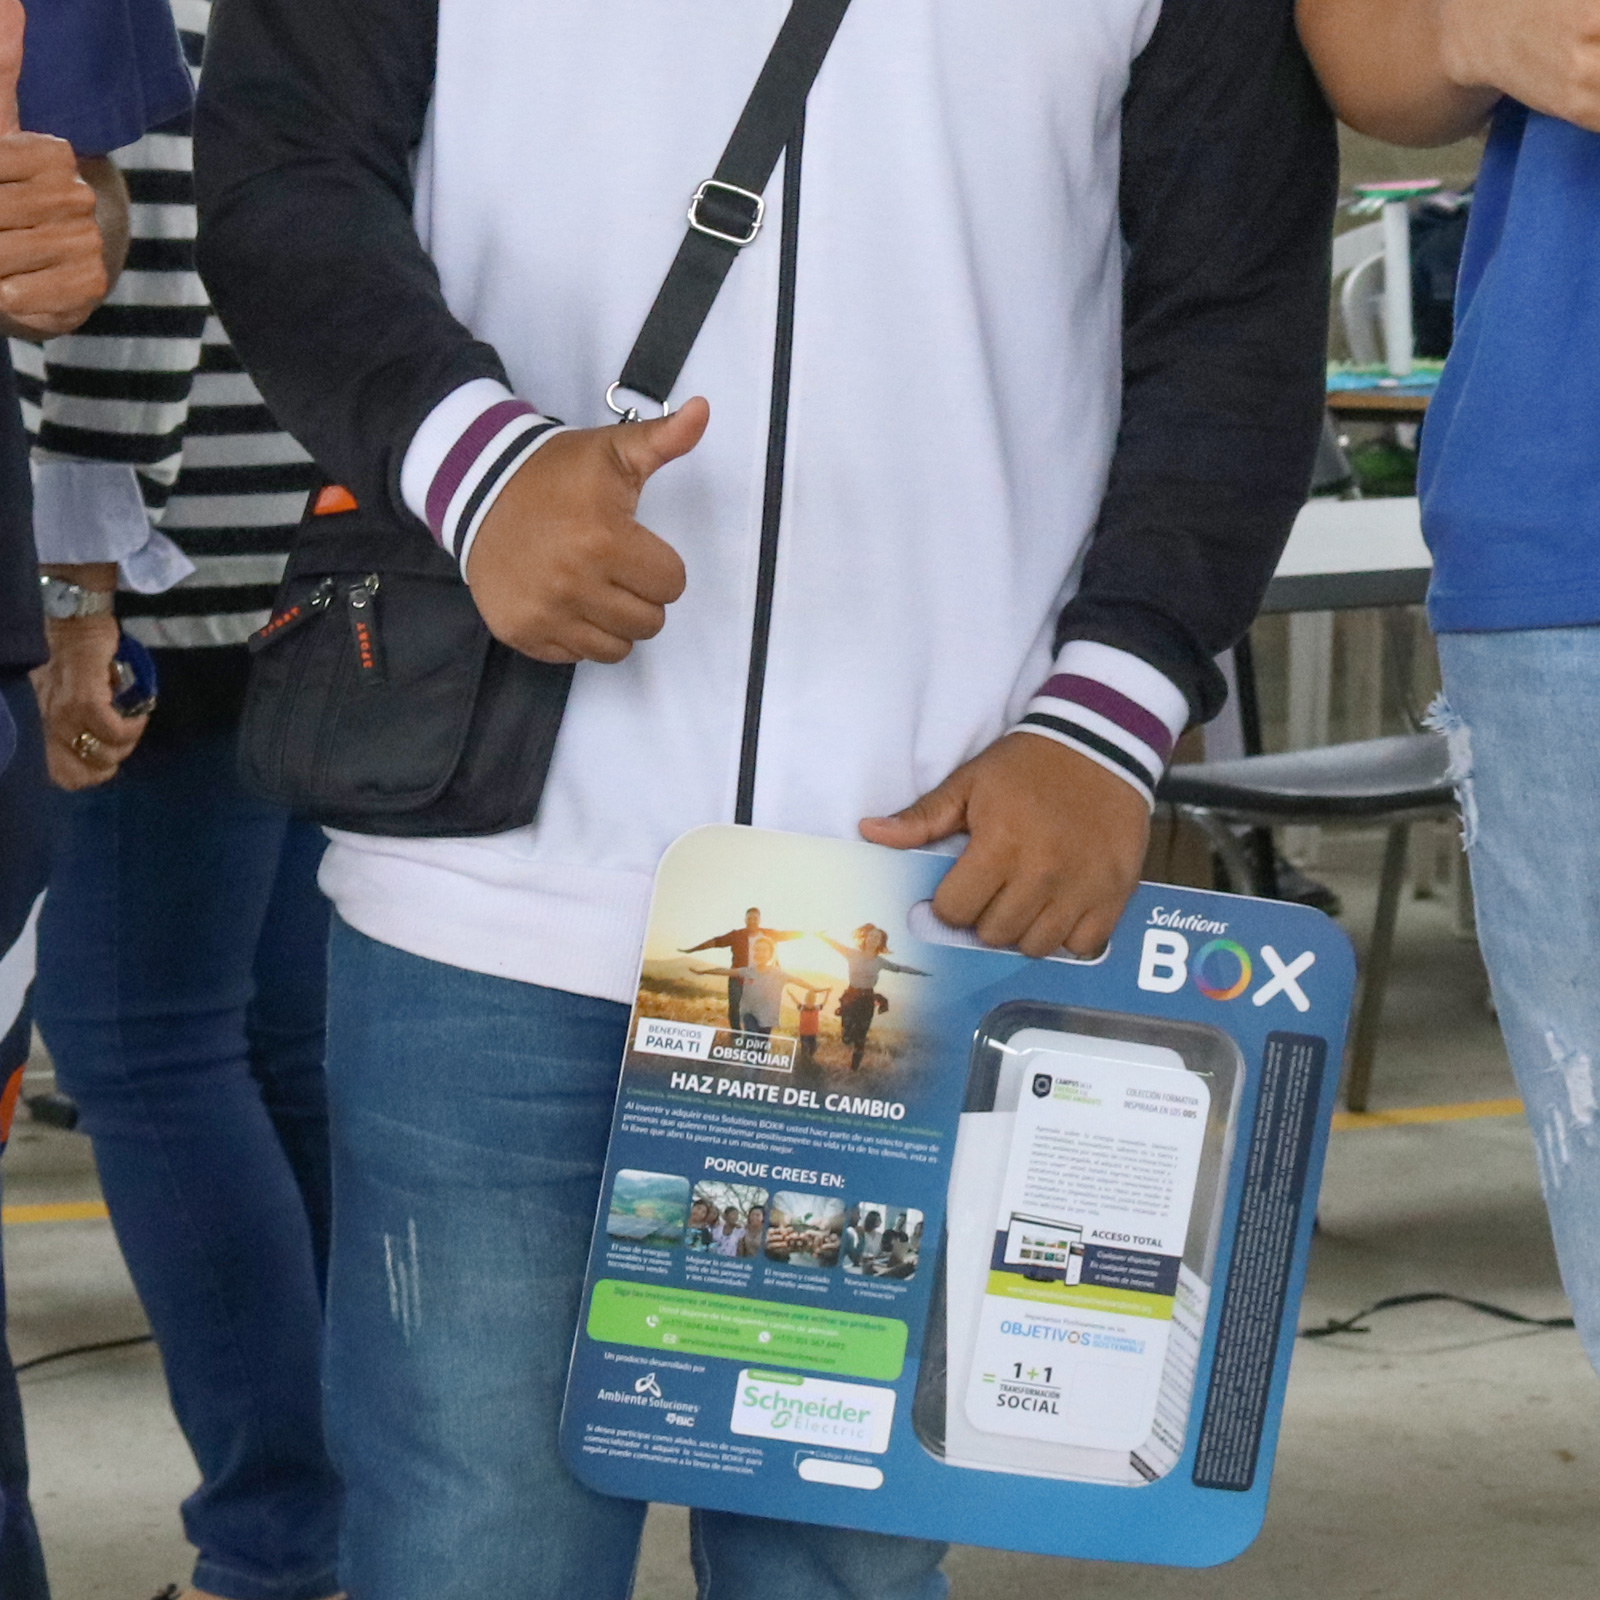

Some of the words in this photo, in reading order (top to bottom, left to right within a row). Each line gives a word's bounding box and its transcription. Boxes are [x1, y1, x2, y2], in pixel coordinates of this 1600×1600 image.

[1146, 905, 1229, 935] Solutions
[1137, 928, 1316, 1013] BOX
[648, 1024, 702, 1038] BENEFICIOS
[645, 1035, 683, 1050] PARA
[688, 1041, 700, 1053] TI
[745, 1038, 772, 1051] para
[712, 1045, 790, 1068] OBSEQUIAR
[670, 1072, 714, 1094] HAZ
[717, 1079, 779, 1103] PARTE
[783, 1087, 820, 1109] DEL
[825, 1094, 906, 1120] CAMBIO
[625, 1101, 634, 1110] Al
[636, 1103, 664, 1114] invertir
[671, 1108, 702, 1119] adquirir
[721, 1114, 757, 1127] Solutions
[704, 1156, 769, 1179] PORQUE
[771, 1166, 817, 1185] CREES
[820, 1173, 846, 1189] EN:
[1091, 1230, 1131, 1243] ACCESO
[1132, 1236, 1163, 1248] TOTAL
[999, 1320, 1091, 1346] OBJETIVOS
[615, 1355, 649, 1365] producto
[598, 1389, 647, 1406] Ambiente
[649, 1396, 698, 1413] Soluciones
[742, 1386, 871, 1424] Schneider
[997, 1394, 1060, 1415] SOCIAL
[794, 1415, 864, 1439] Electric
